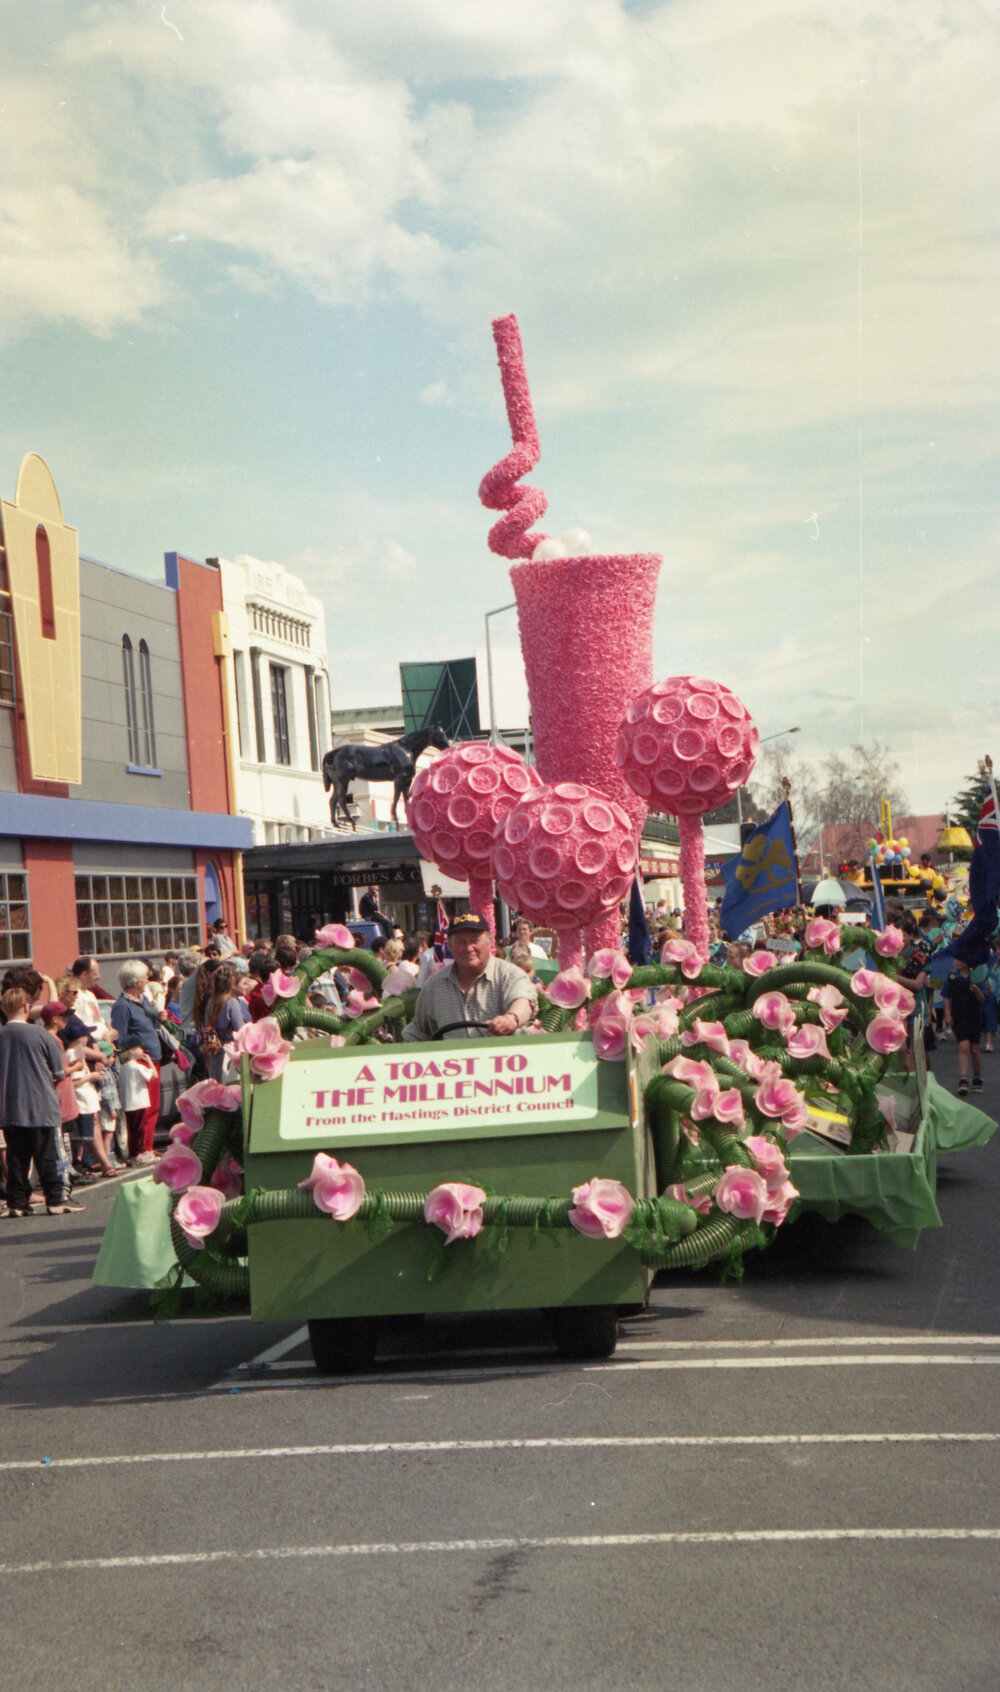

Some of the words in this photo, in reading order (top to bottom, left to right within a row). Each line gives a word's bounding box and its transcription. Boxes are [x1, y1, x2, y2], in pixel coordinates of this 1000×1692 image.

[333, 872, 389, 886] FORBES
[394, 870, 404, 881] &
[354, 1065, 376, 1083] A
[385, 1057, 480, 1079] TOAST
[489, 1054, 528, 1074] TO
[310, 1088, 374, 1109] THE
[383, 1073, 573, 1104] MILLENNIUM
[305, 1114, 346, 1127] From
[351, 1112, 376, 1124] the
[381, 1108, 448, 1122] Hastings
[453, 1103, 511, 1117] District
[516, 1097, 575, 1113] Council
